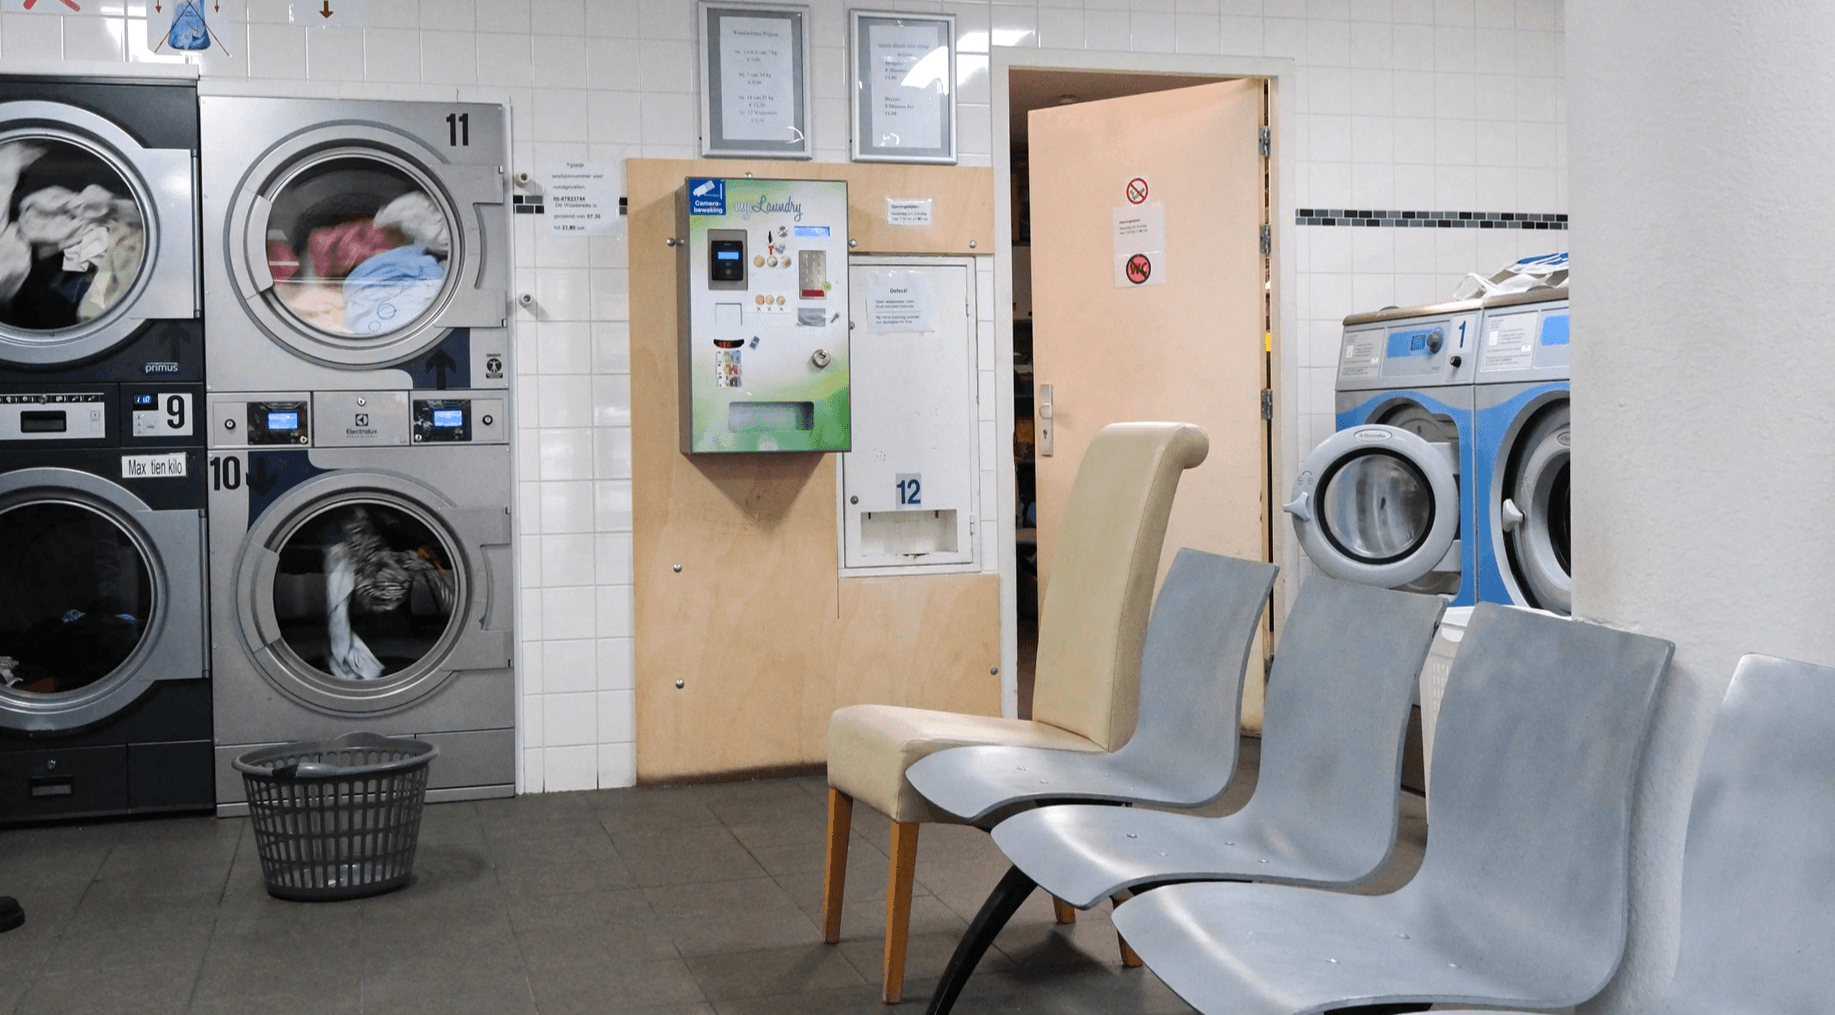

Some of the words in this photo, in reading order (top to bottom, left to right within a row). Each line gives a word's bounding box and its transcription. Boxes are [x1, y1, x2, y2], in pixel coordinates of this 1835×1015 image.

[446, 113, 468, 146] 11
[751, 194, 804, 222] Laundry
[1458, 320, 1466, 348] 1
[145, 362, 178, 374] primus
[166, 395, 184, 429] 9
[128, 459, 146, 475] Max
[151, 458, 166, 474] tien
[168, 458, 182, 474] kilo
[210, 456, 240, 490] 10
[896, 479, 921, 504] 12
